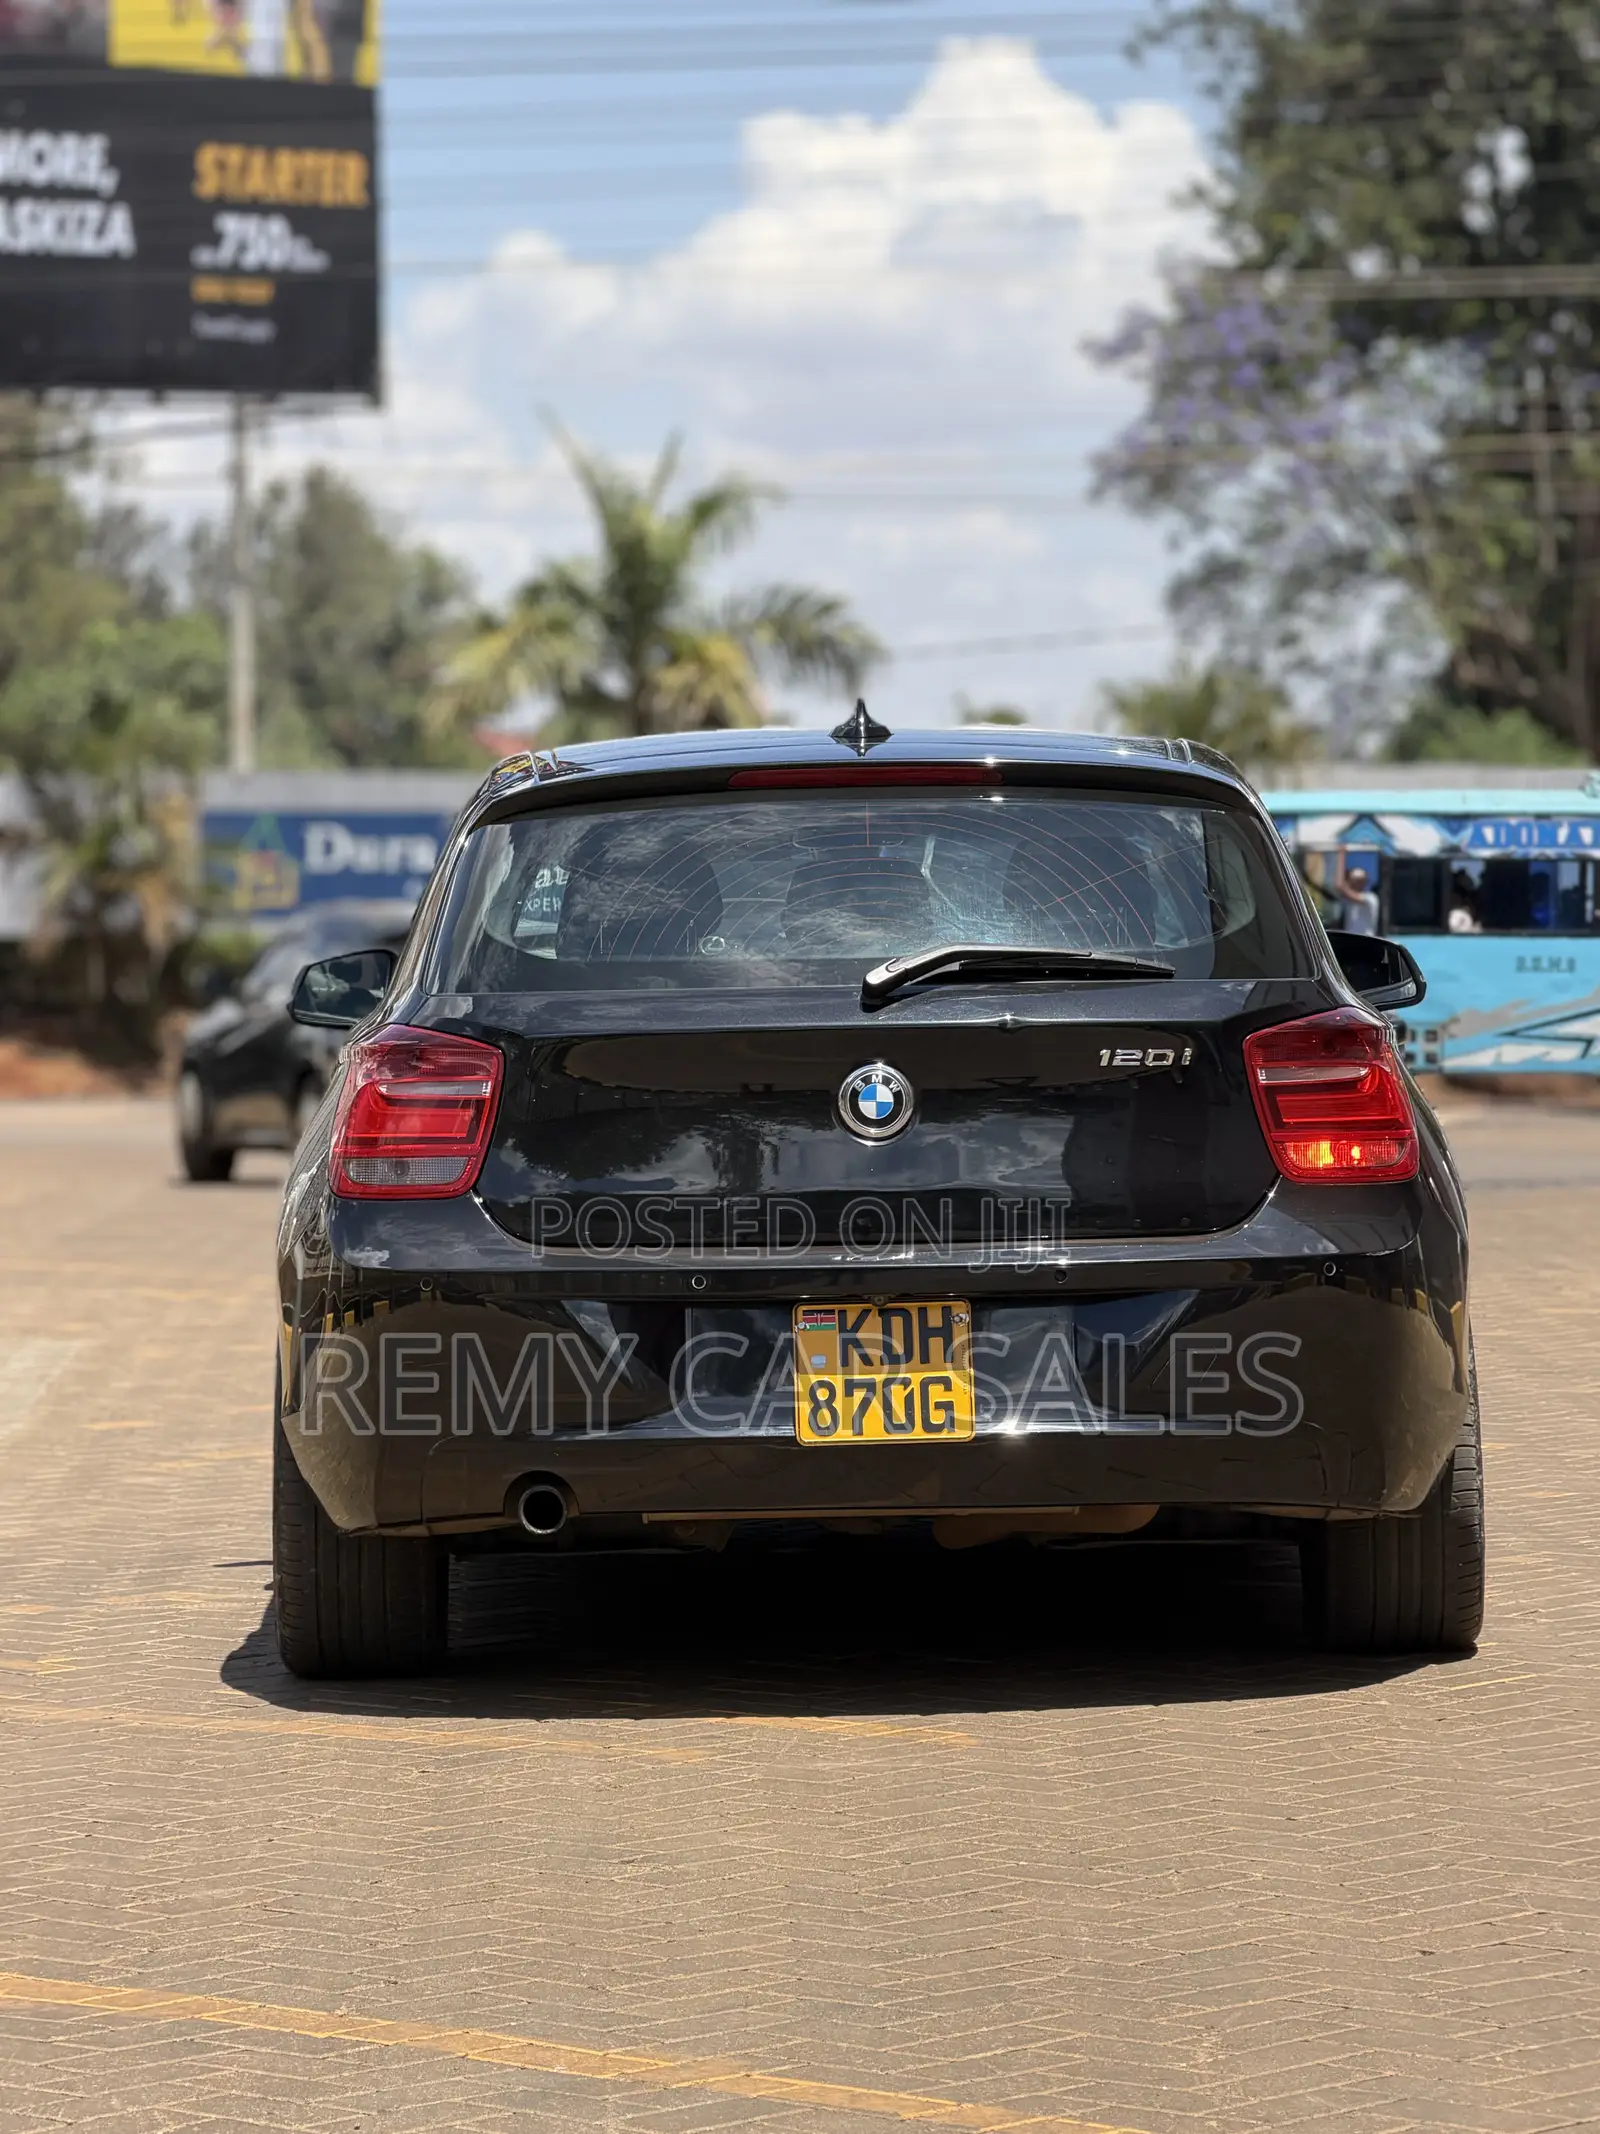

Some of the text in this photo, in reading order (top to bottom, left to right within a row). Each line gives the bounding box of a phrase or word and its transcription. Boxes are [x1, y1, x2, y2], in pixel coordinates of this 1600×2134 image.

[195, 142, 368, 207] STARTER
[854, 1074, 901, 1093] BMW
[1100, 1048, 1193, 1066] 120i
[837, 1306, 956, 1367] KDH
[808, 1375, 956, 1437] 870G
